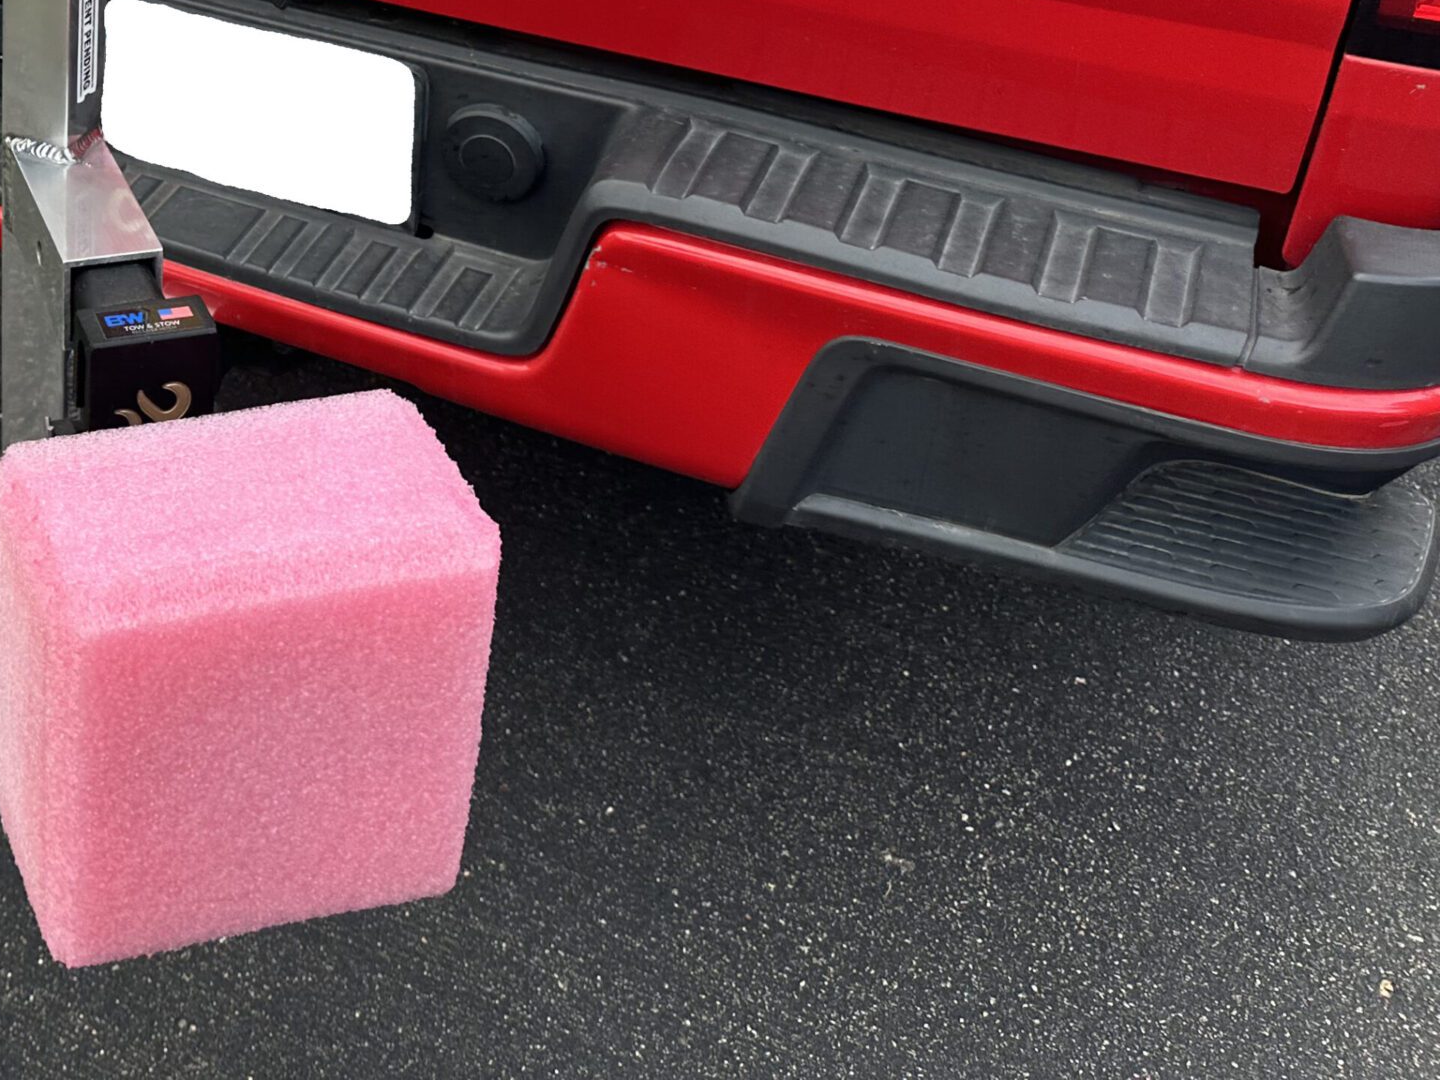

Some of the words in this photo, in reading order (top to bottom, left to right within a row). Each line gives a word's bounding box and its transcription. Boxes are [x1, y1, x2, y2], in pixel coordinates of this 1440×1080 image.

[82, 30, 92, 91] PENDING
[123, 323, 145, 332] TOW
[154, 320, 181, 328] STOW
